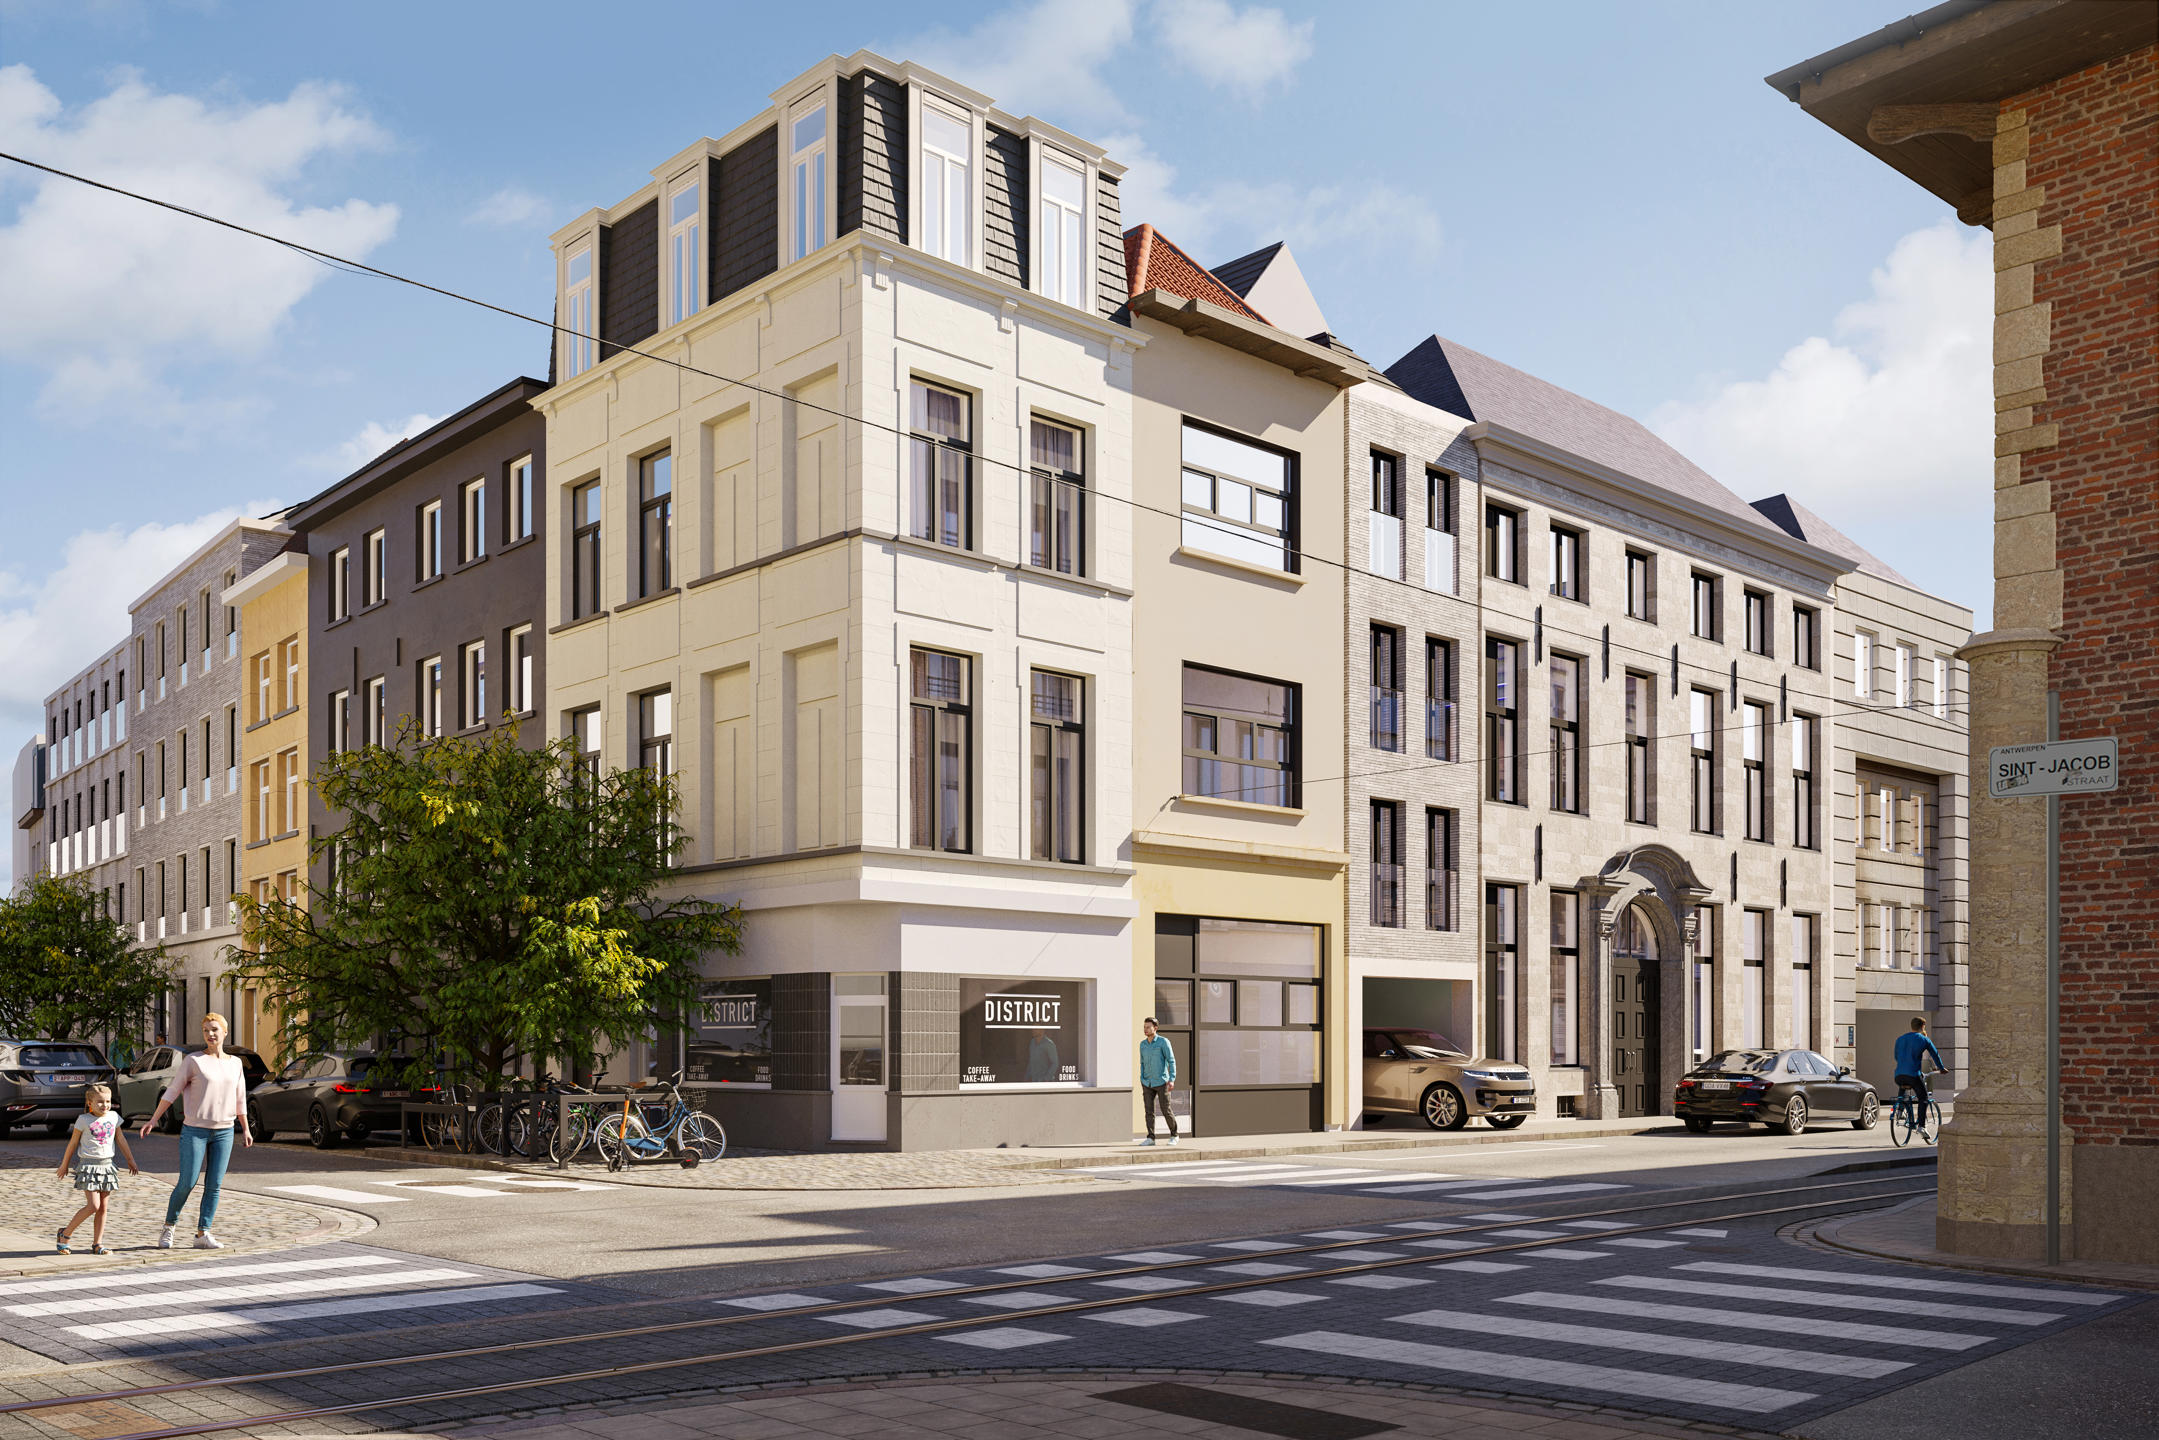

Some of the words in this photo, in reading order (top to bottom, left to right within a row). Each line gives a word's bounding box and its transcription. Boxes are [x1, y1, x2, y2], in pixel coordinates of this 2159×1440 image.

[2067, 775, 2109, 786] STRAAT
[985, 1001, 1060, 1022] DISTRICT
[690, 1065, 704, 1073] COFFEE
[968, 1066, 990, 1074] COFFEE
[1062, 1065, 1076, 1073] FOOD
[962, 1074, 996, 1082] TAKE-AWAY
